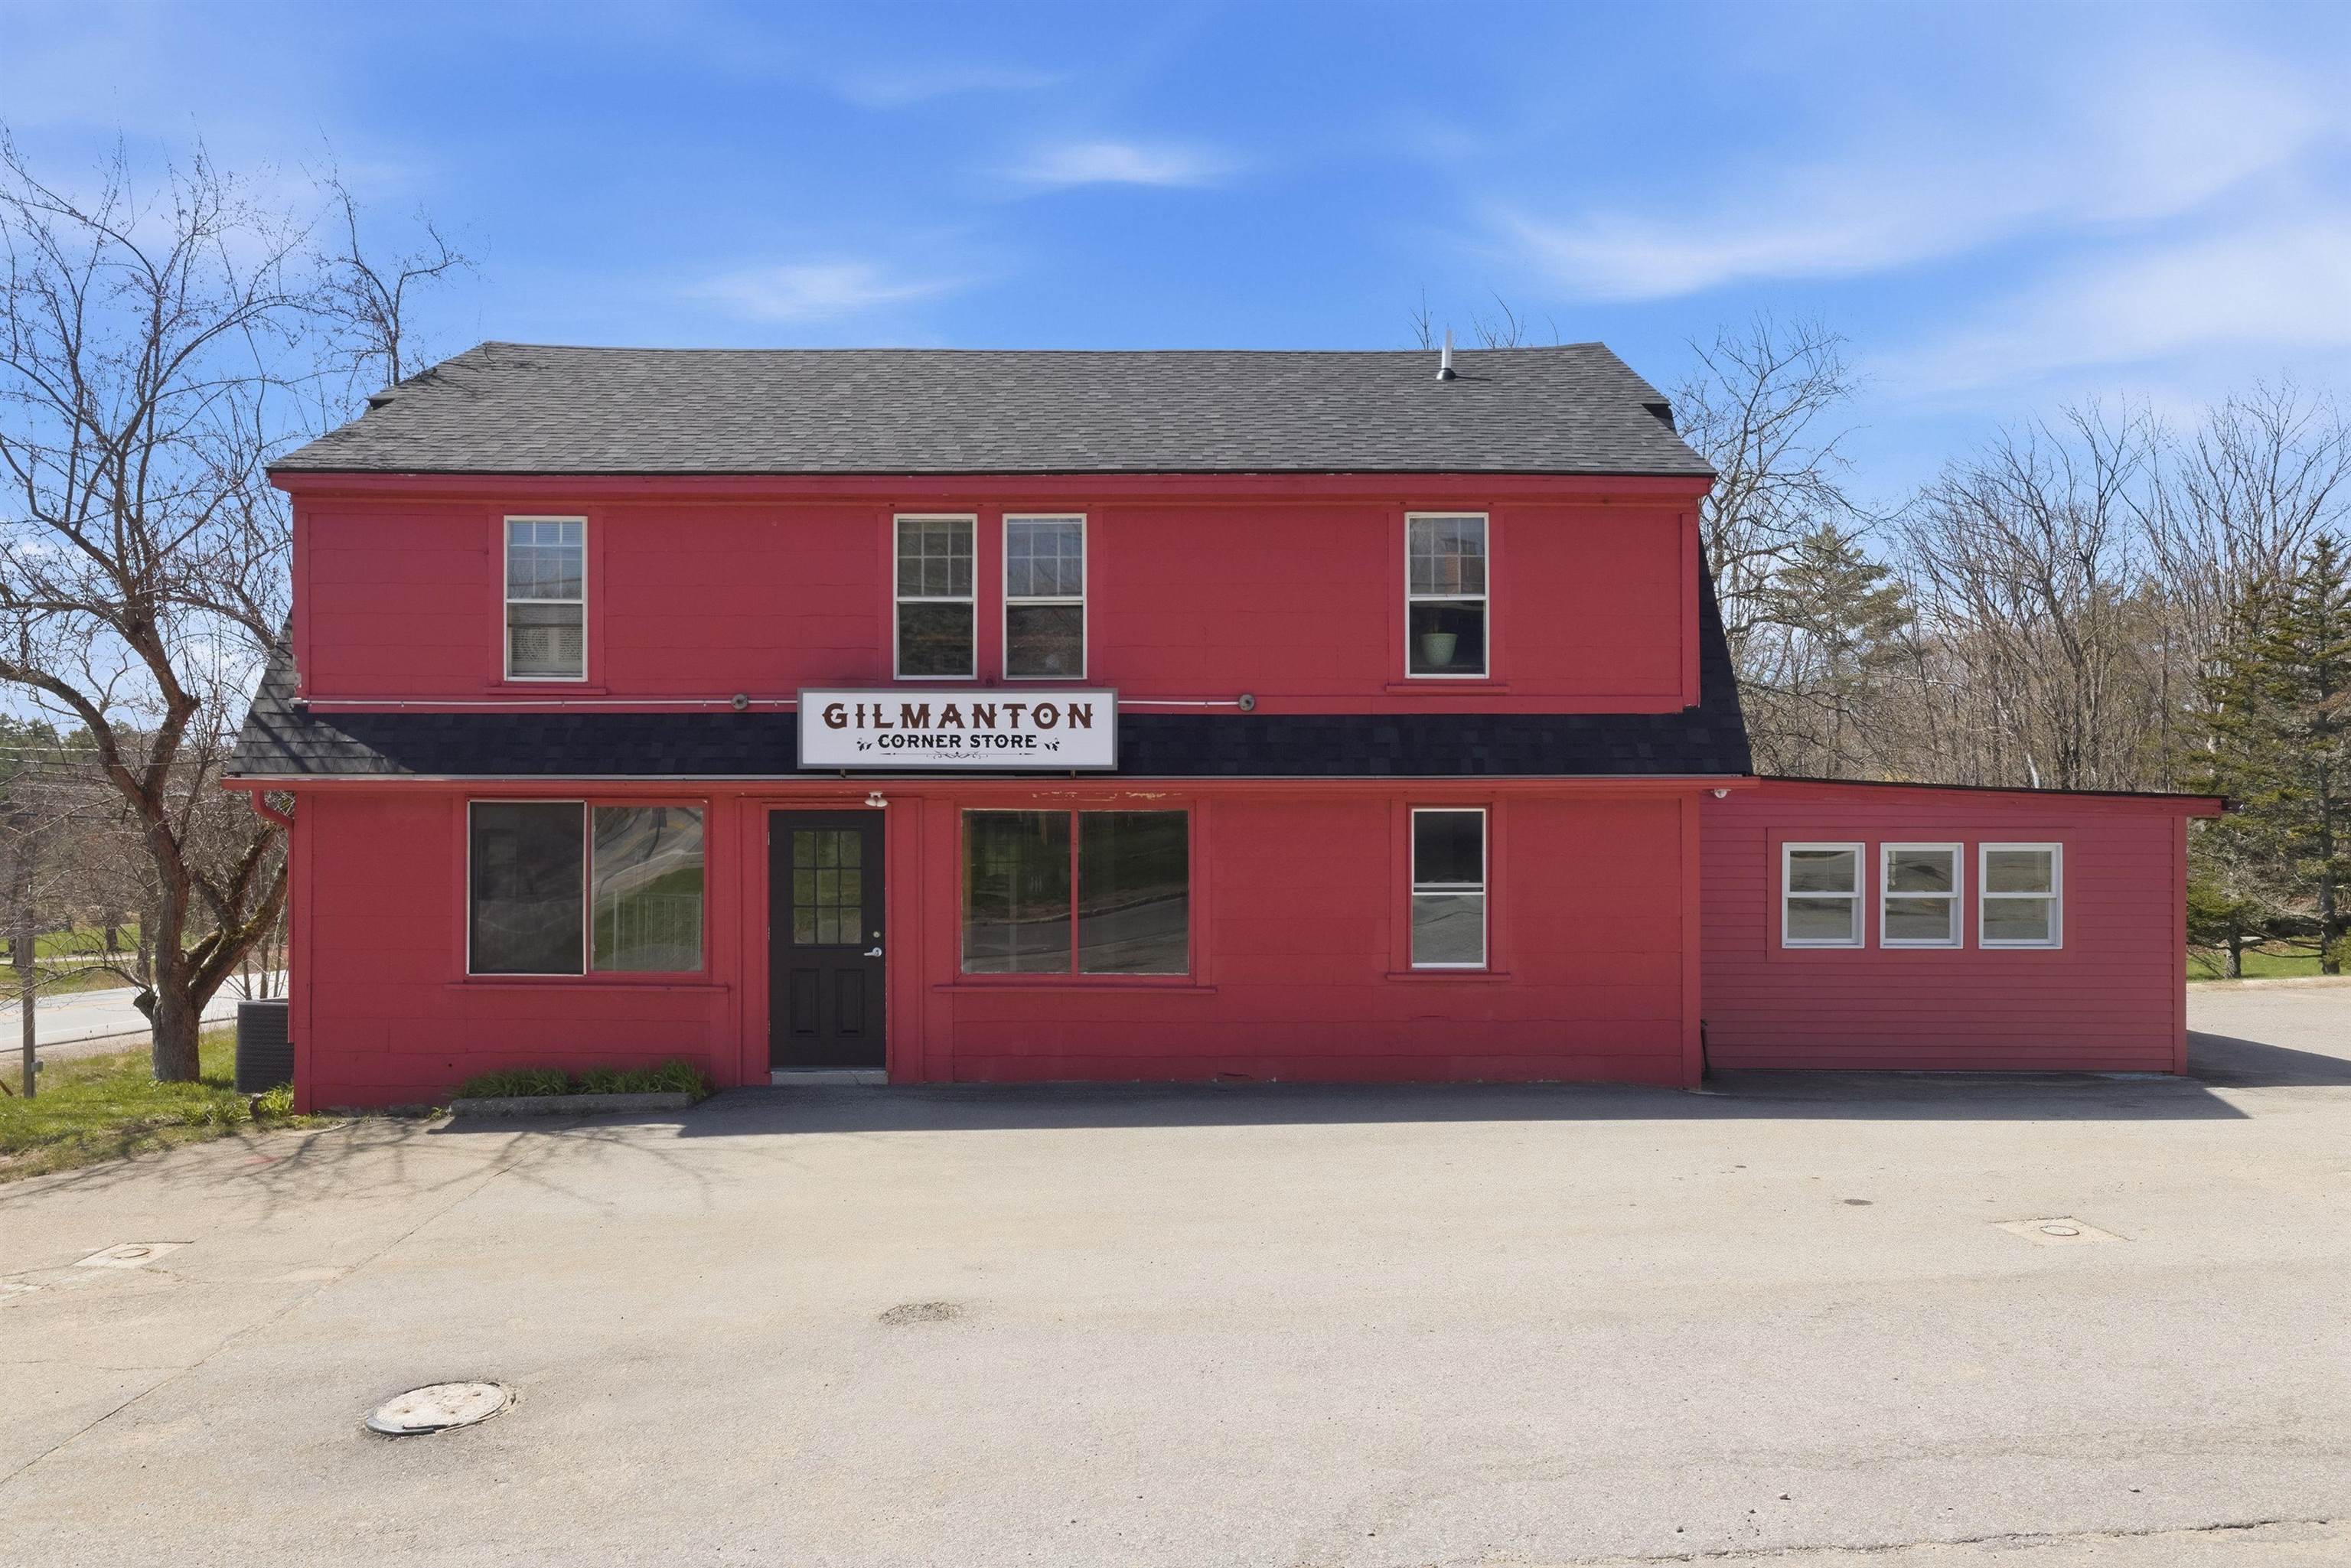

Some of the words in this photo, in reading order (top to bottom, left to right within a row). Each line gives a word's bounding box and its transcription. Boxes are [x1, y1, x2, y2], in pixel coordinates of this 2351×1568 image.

[821, 702, 1094, 730] GILMANTON
[877, 733, 962, 749] CORNER
[970, 733, 1038, 749] STORE
